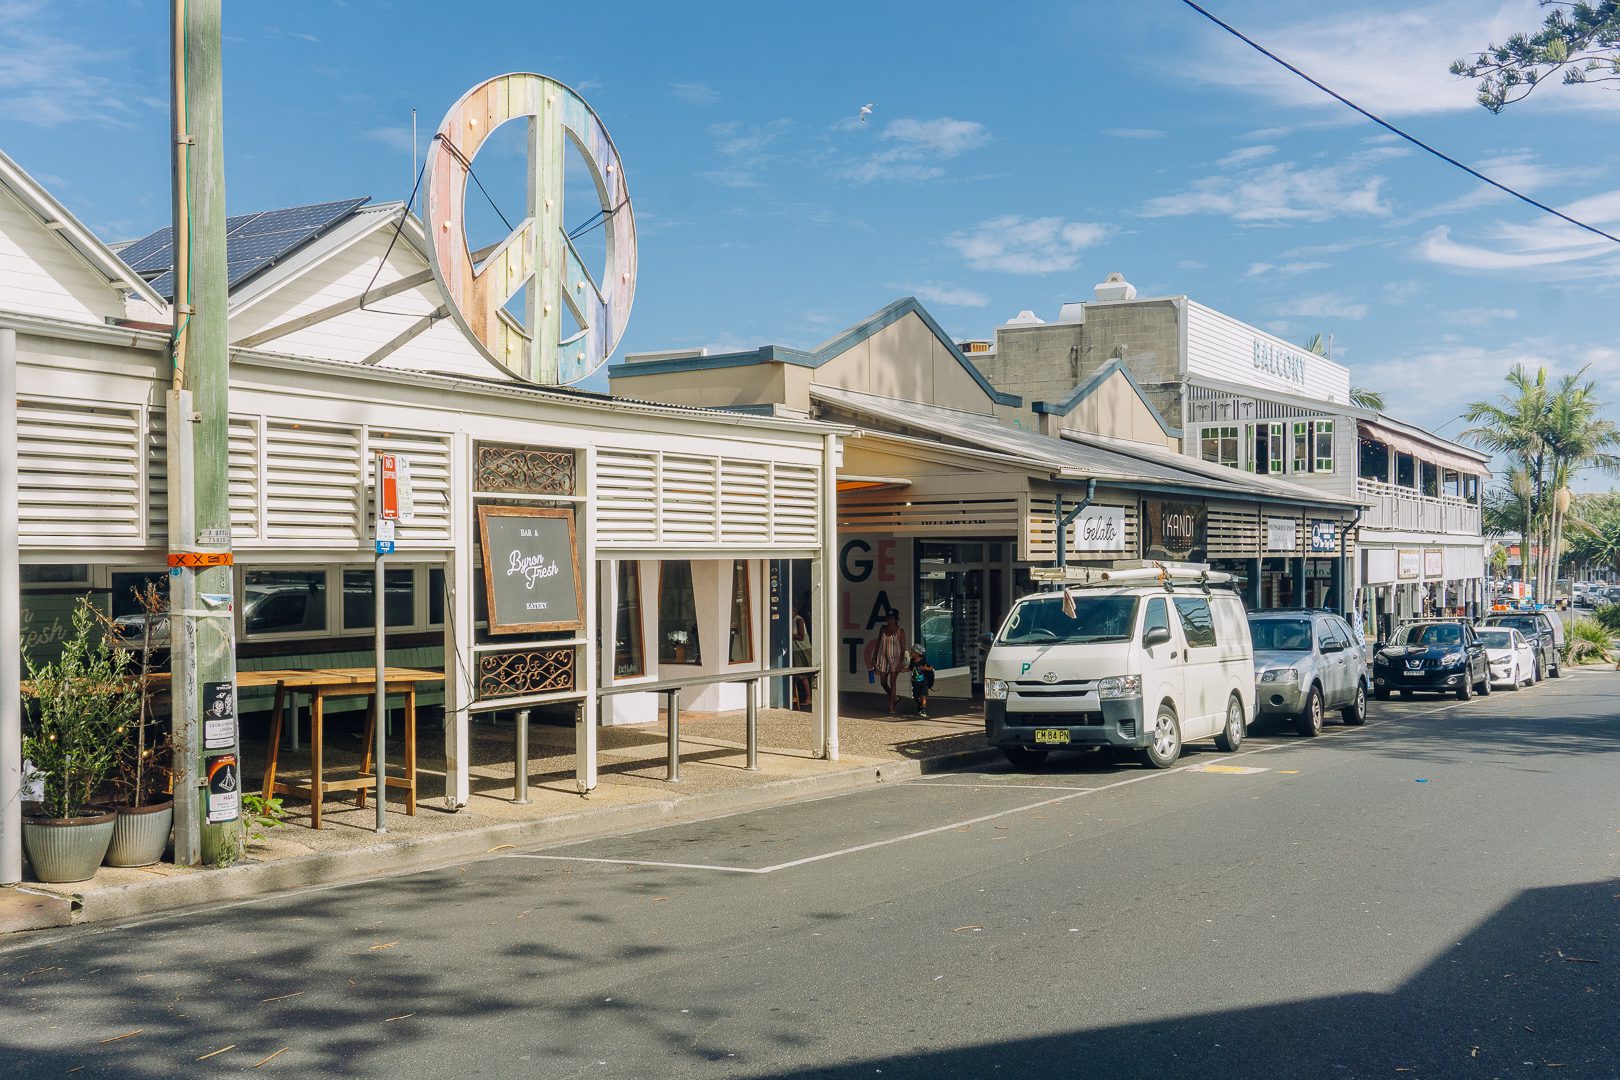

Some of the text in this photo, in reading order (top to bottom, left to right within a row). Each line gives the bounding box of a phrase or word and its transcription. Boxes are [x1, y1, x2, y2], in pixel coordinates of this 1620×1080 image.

[1253, 336, 1305, 385] BALCONY
[520, 529, 539, 537] BAR &
[1083, 516, 1118, 541] Gelato
[507, 549, 545, 576] Byron
[525, 559, 559, 590] Fresh
[526, 602, 548, 610] EATERY
[1021, 662, 1031, 675] P
